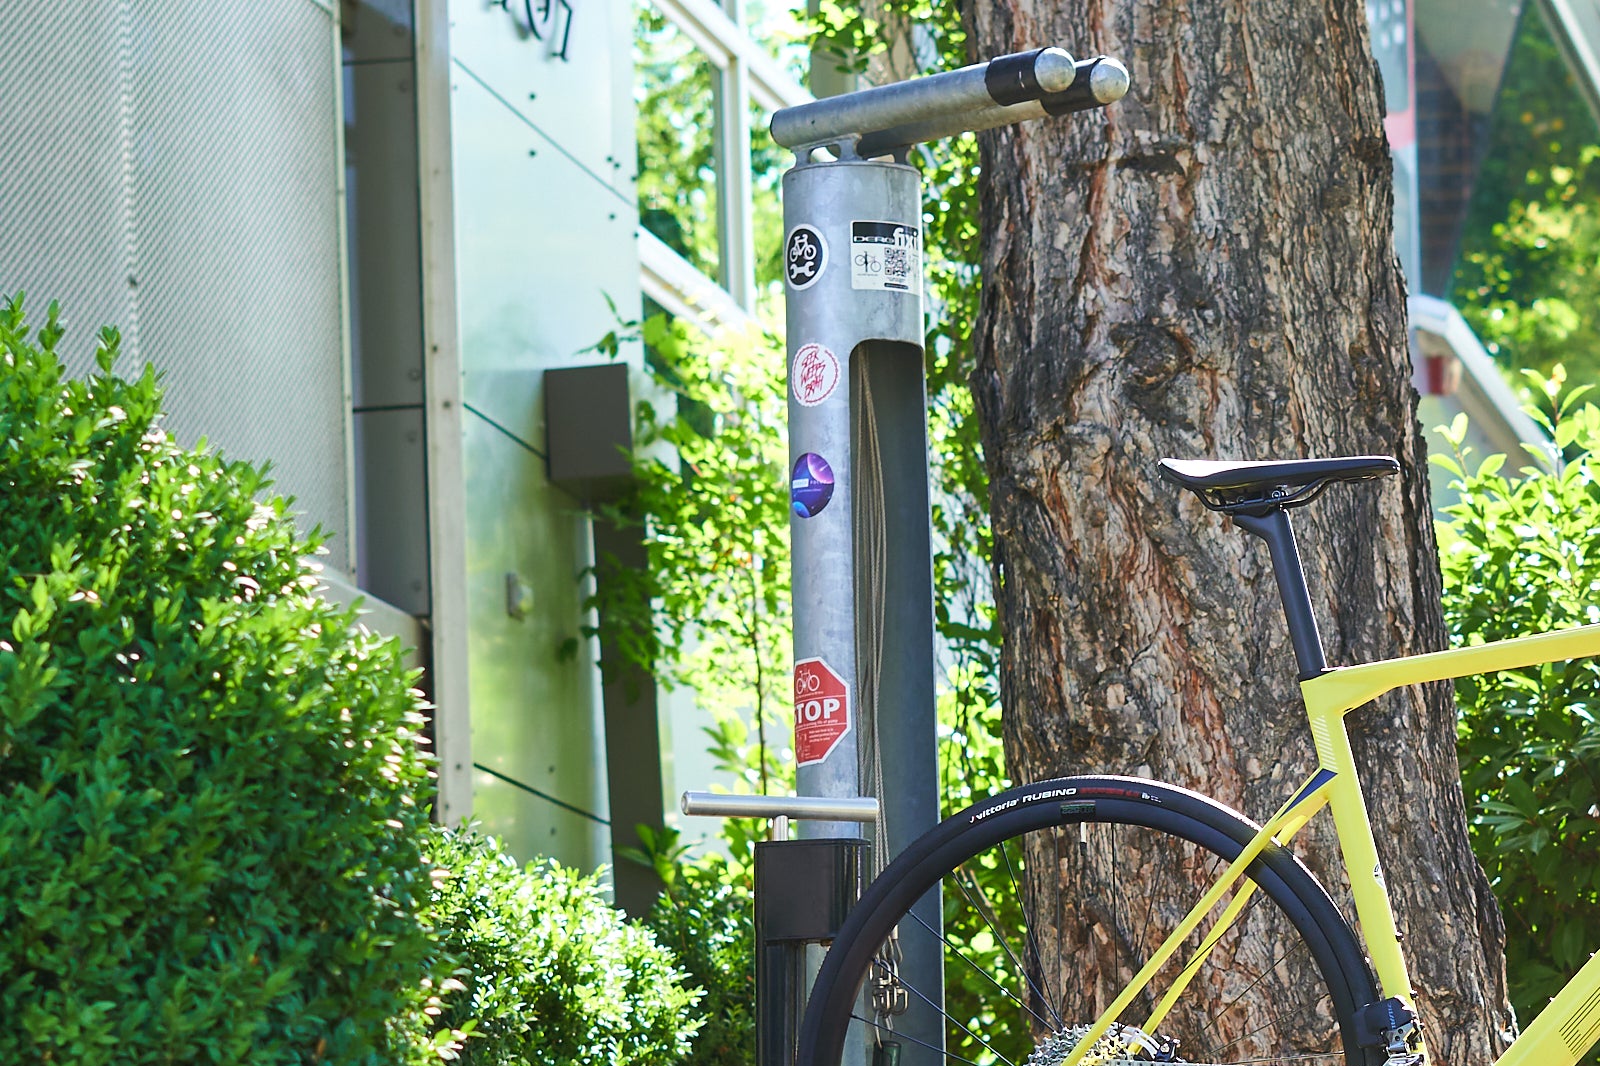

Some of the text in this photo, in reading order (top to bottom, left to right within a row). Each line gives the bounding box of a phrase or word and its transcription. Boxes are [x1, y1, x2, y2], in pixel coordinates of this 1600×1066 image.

[794, 698, 840, 724] TOP
[976, 799, 1017, 820] vittoria
[1022, 787, 1078, 803] RUBINO
